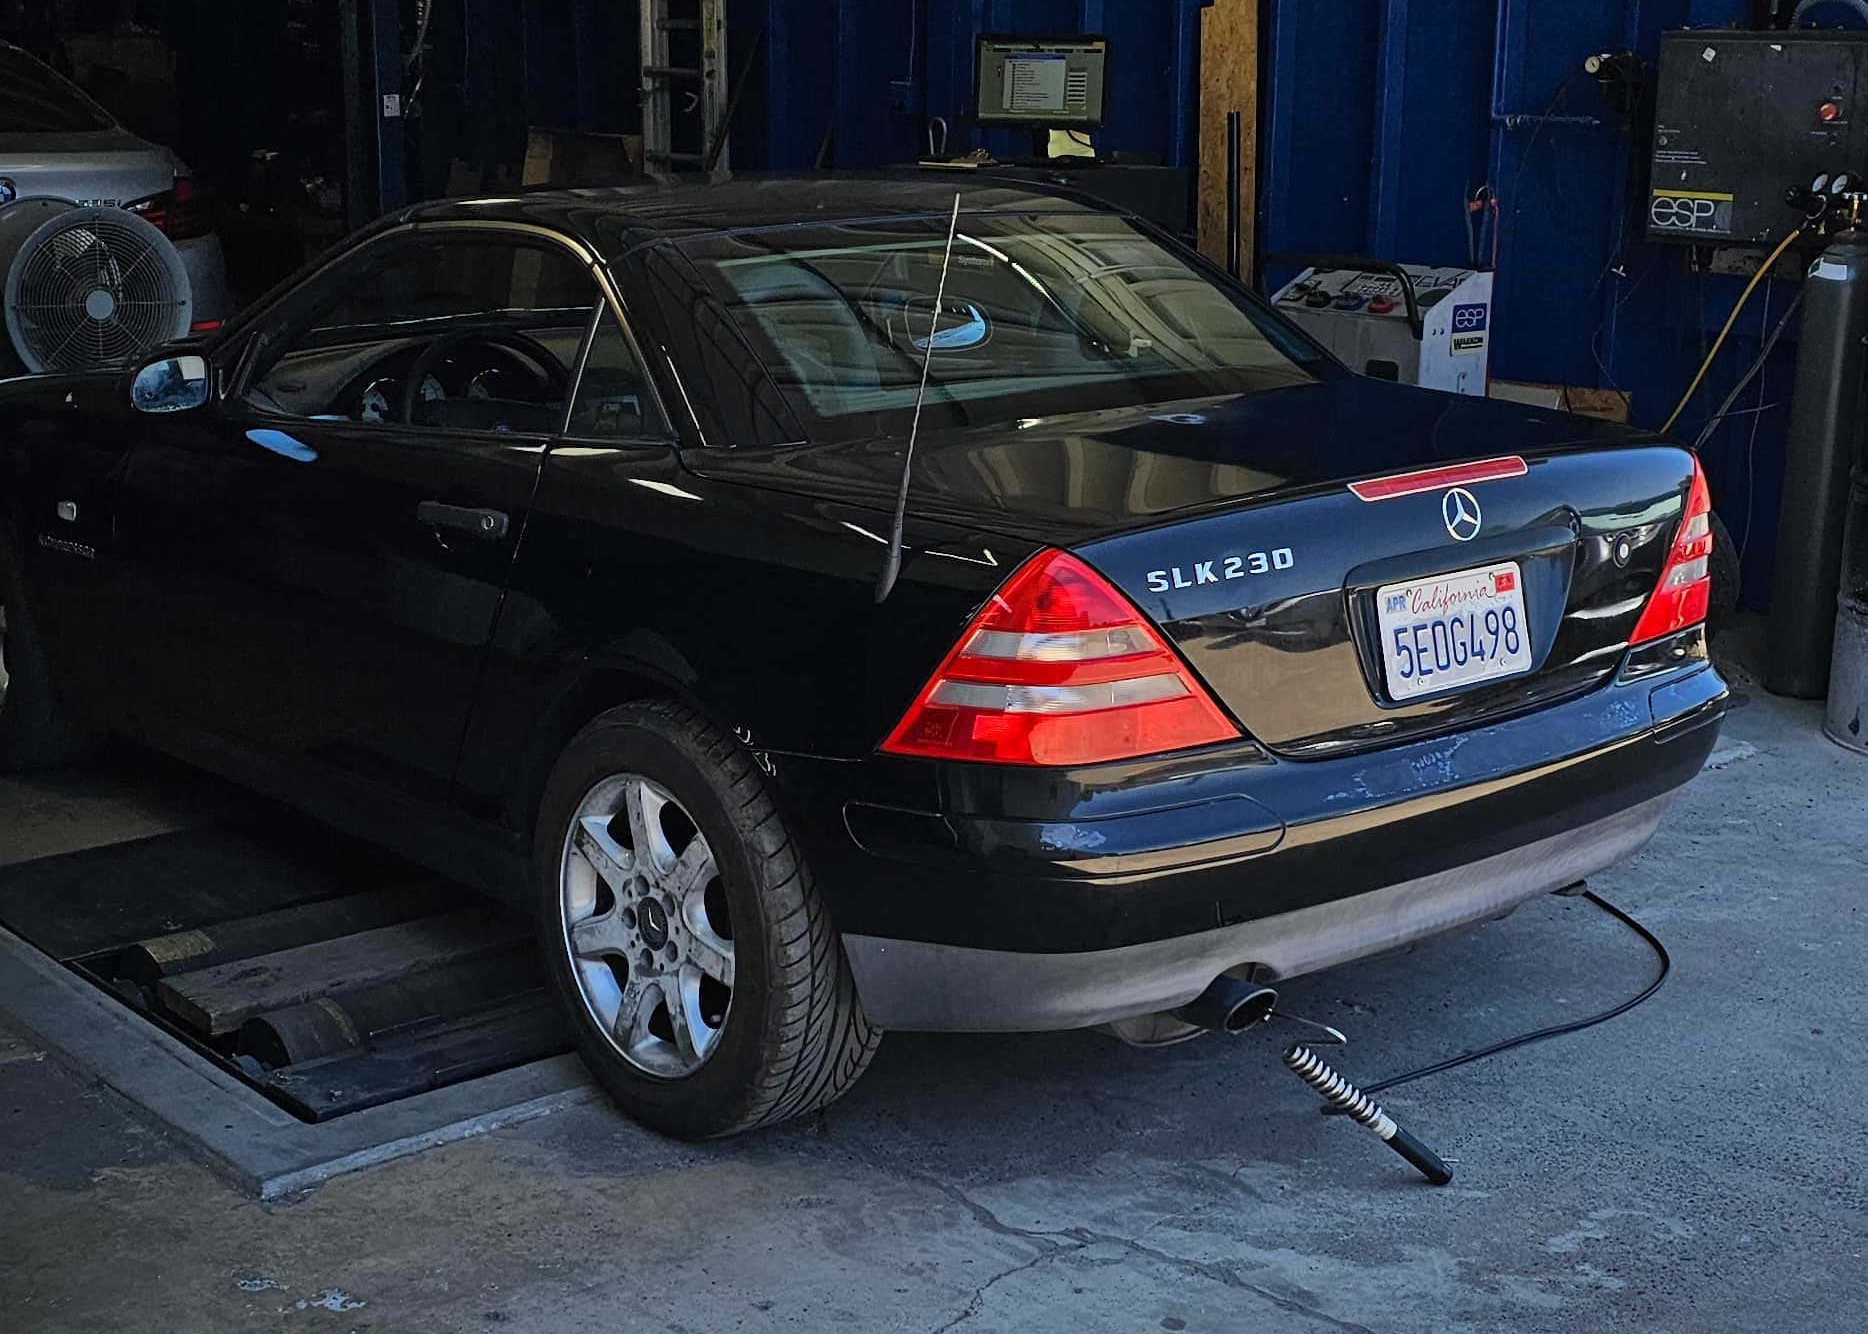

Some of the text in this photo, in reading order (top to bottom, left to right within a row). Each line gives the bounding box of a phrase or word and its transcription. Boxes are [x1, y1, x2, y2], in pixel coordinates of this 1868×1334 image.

[1146, 547, 1295, 593] SLK230
[1386, 595, 1407, 614] APR
[1411, 581, 1494, 615] California
